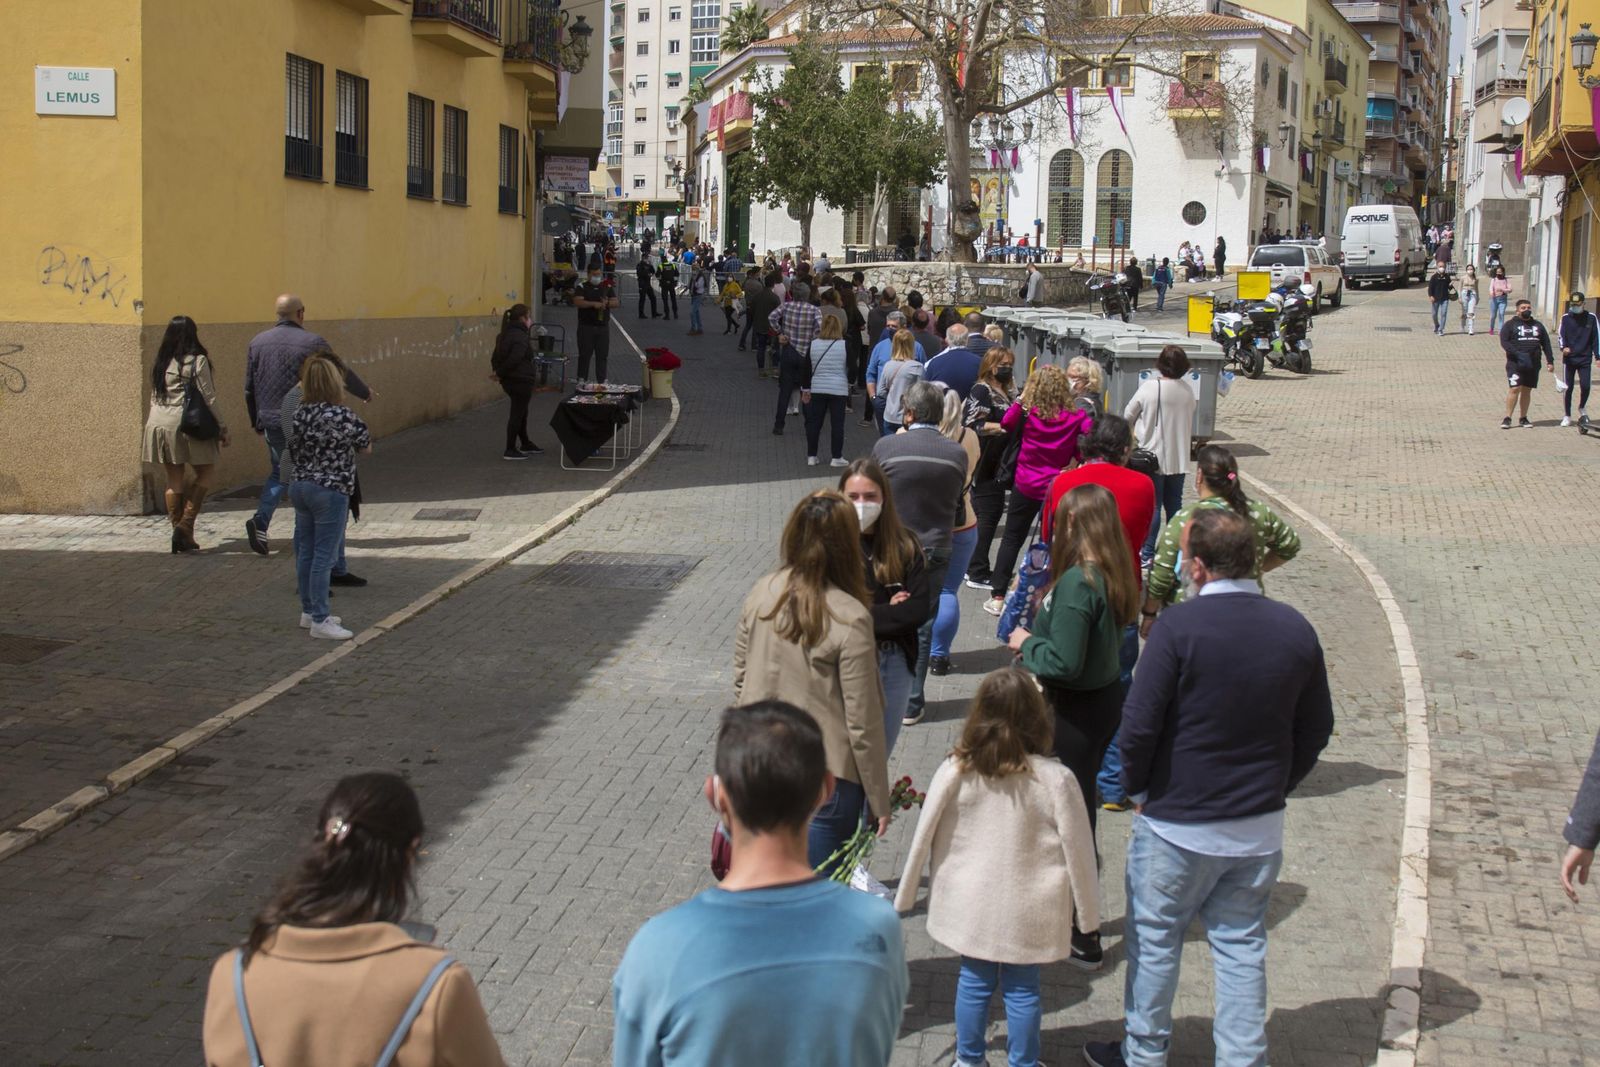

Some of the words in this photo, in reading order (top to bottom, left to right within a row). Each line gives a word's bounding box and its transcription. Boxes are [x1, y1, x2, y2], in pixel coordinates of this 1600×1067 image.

[67, 71, 90, 81] CALLE
[47, 91, 101, 104] LEMUS
[1350, 213, 1389, 223] PROMUSI
